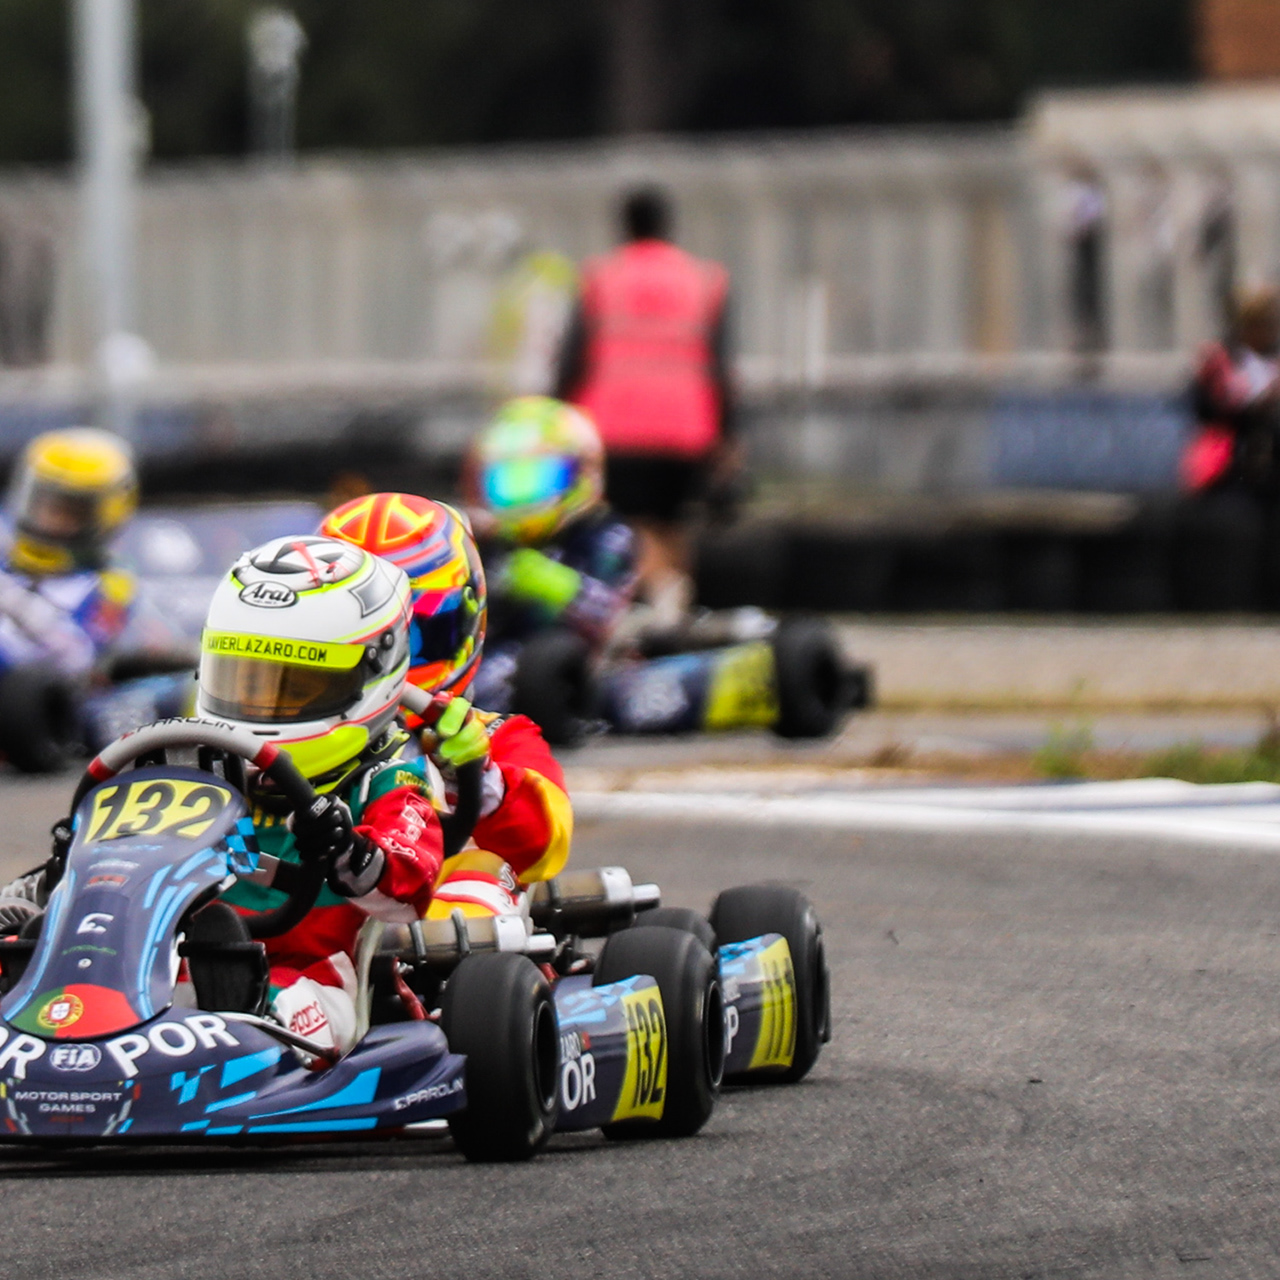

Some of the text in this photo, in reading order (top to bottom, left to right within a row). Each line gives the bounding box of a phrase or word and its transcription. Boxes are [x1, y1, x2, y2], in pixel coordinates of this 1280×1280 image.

[241, 582, 292, 602] Arai
[90, 780, 226, 842] 132
[51, 1045, 96, 1069] FIA
[106, 1014, 241, 1079] POR
[627, 997, 666, 1109] 132
[14, 1089, 123, 1103] MOTORSPORT
[39, 1103, 97, 1114] GAMES
